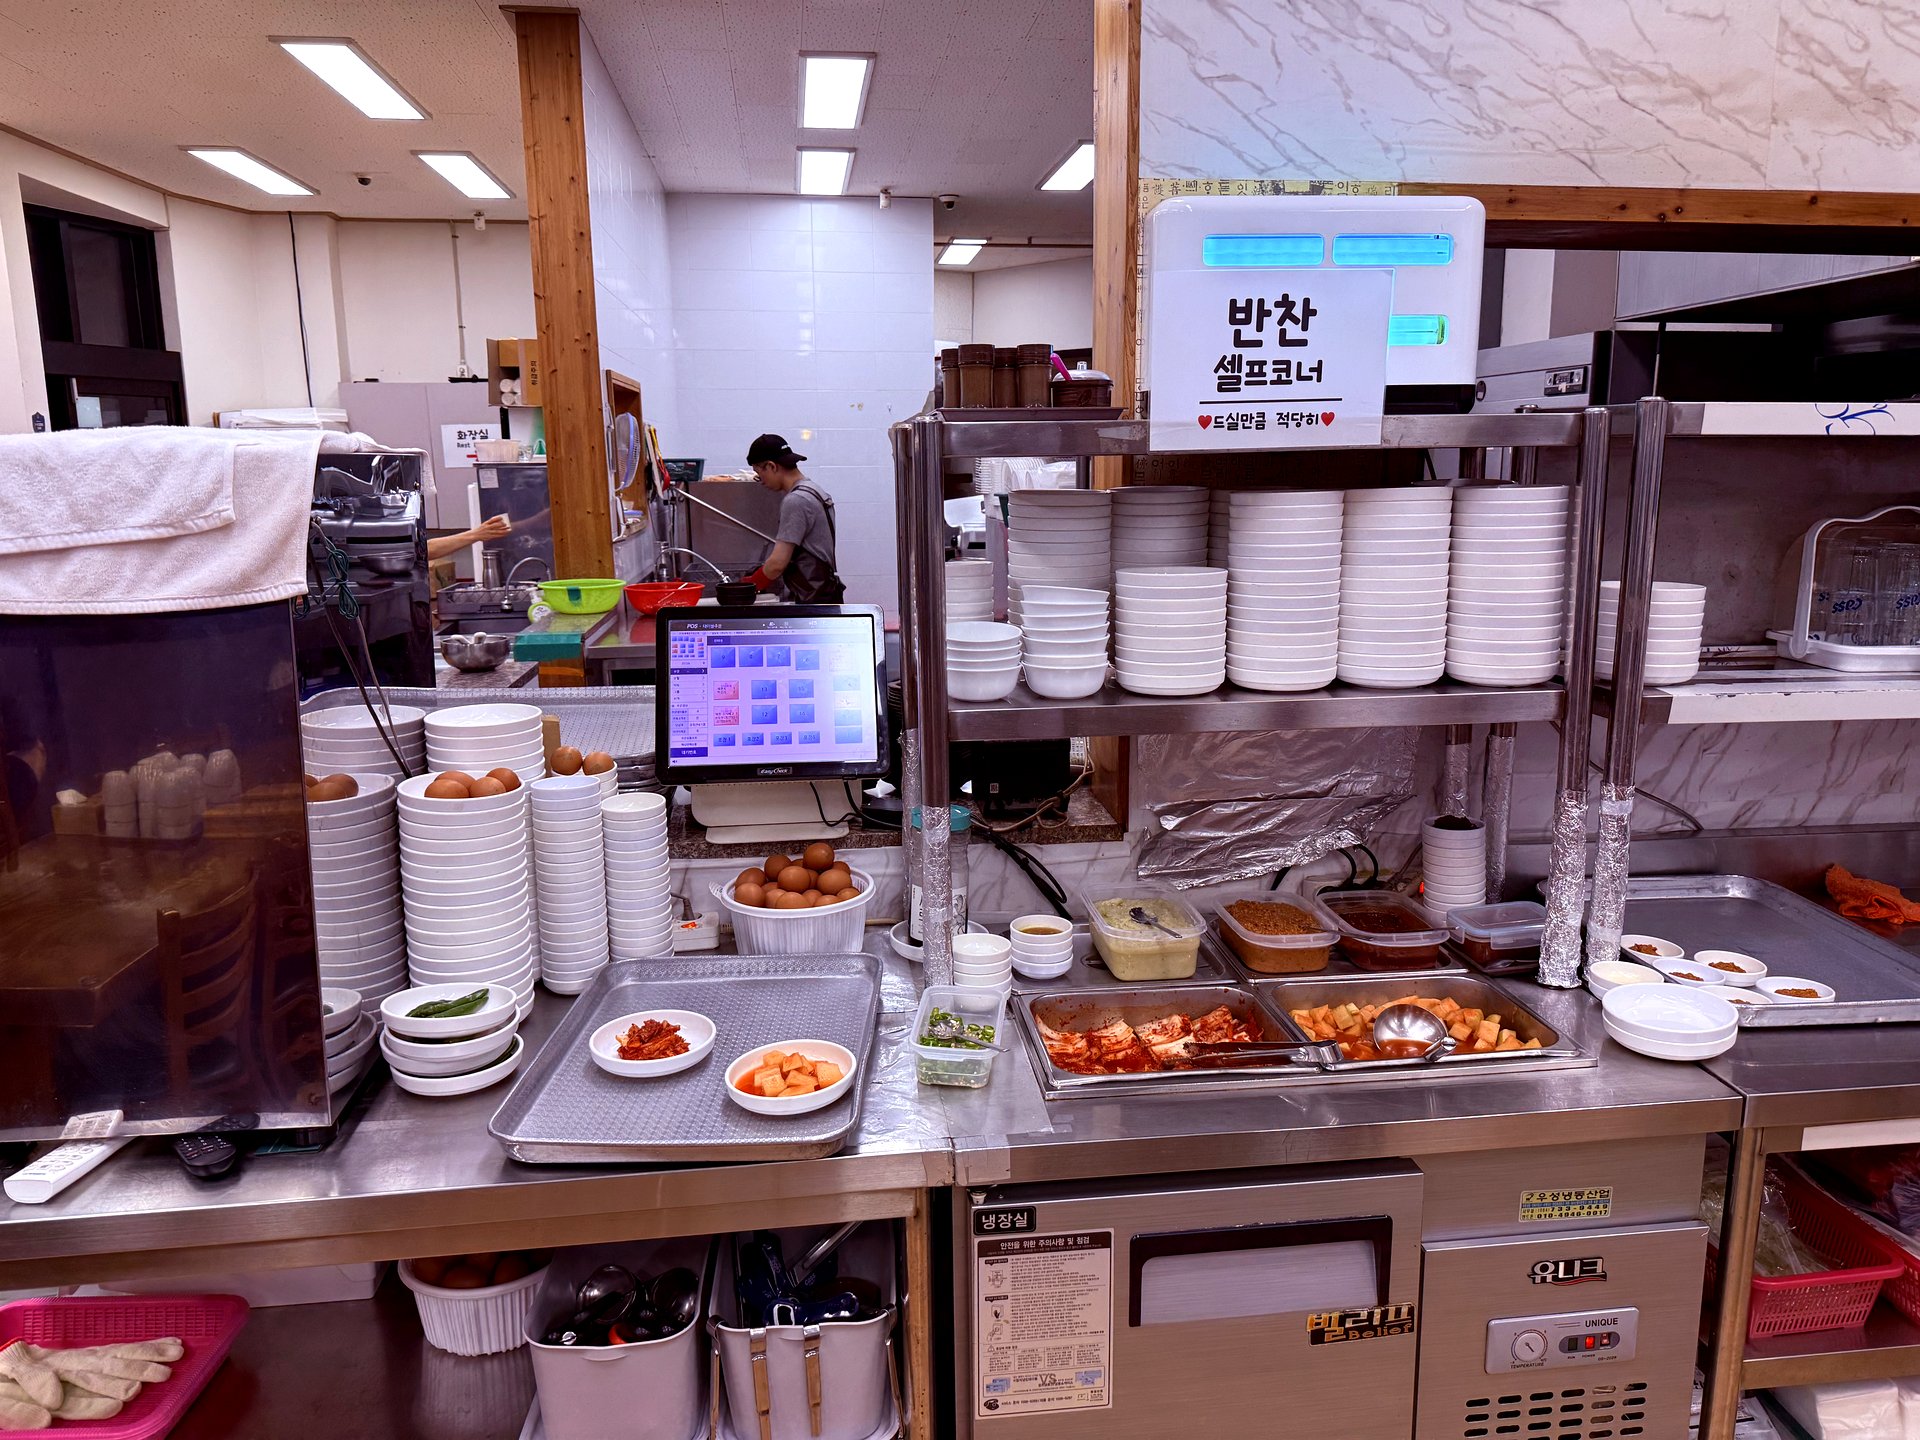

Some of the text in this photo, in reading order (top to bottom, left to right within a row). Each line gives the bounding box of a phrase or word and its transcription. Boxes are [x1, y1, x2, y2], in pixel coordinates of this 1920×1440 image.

[1228, 293, 1318, 348] 반찬
[1213, 354, 1323, 393] 셀프코너
[1213, 412, 1319, 431] 드실만큼 적당히
[457, 428, 489, 440] 화장실
[1536, 1189, 1610, 1202] 우성냉동산업
[982, 1212, 1028, 1230] 냉장실
[1000, 1241, 1020, 1250] 안전을
[1023, 1239, 1037, 1248] 위한
[1038, 1237, 1065, 1247] 주의사항
[1067, 1236, 1074, 1246] 및
[1076, 1235, 1090, 1245] 점검
[1530, 1258, 1606, 1284] 유니크
[1348, 1323, 1412, 1340] Belief
[1585, 1318, 1619, 1328] UNIQUE
